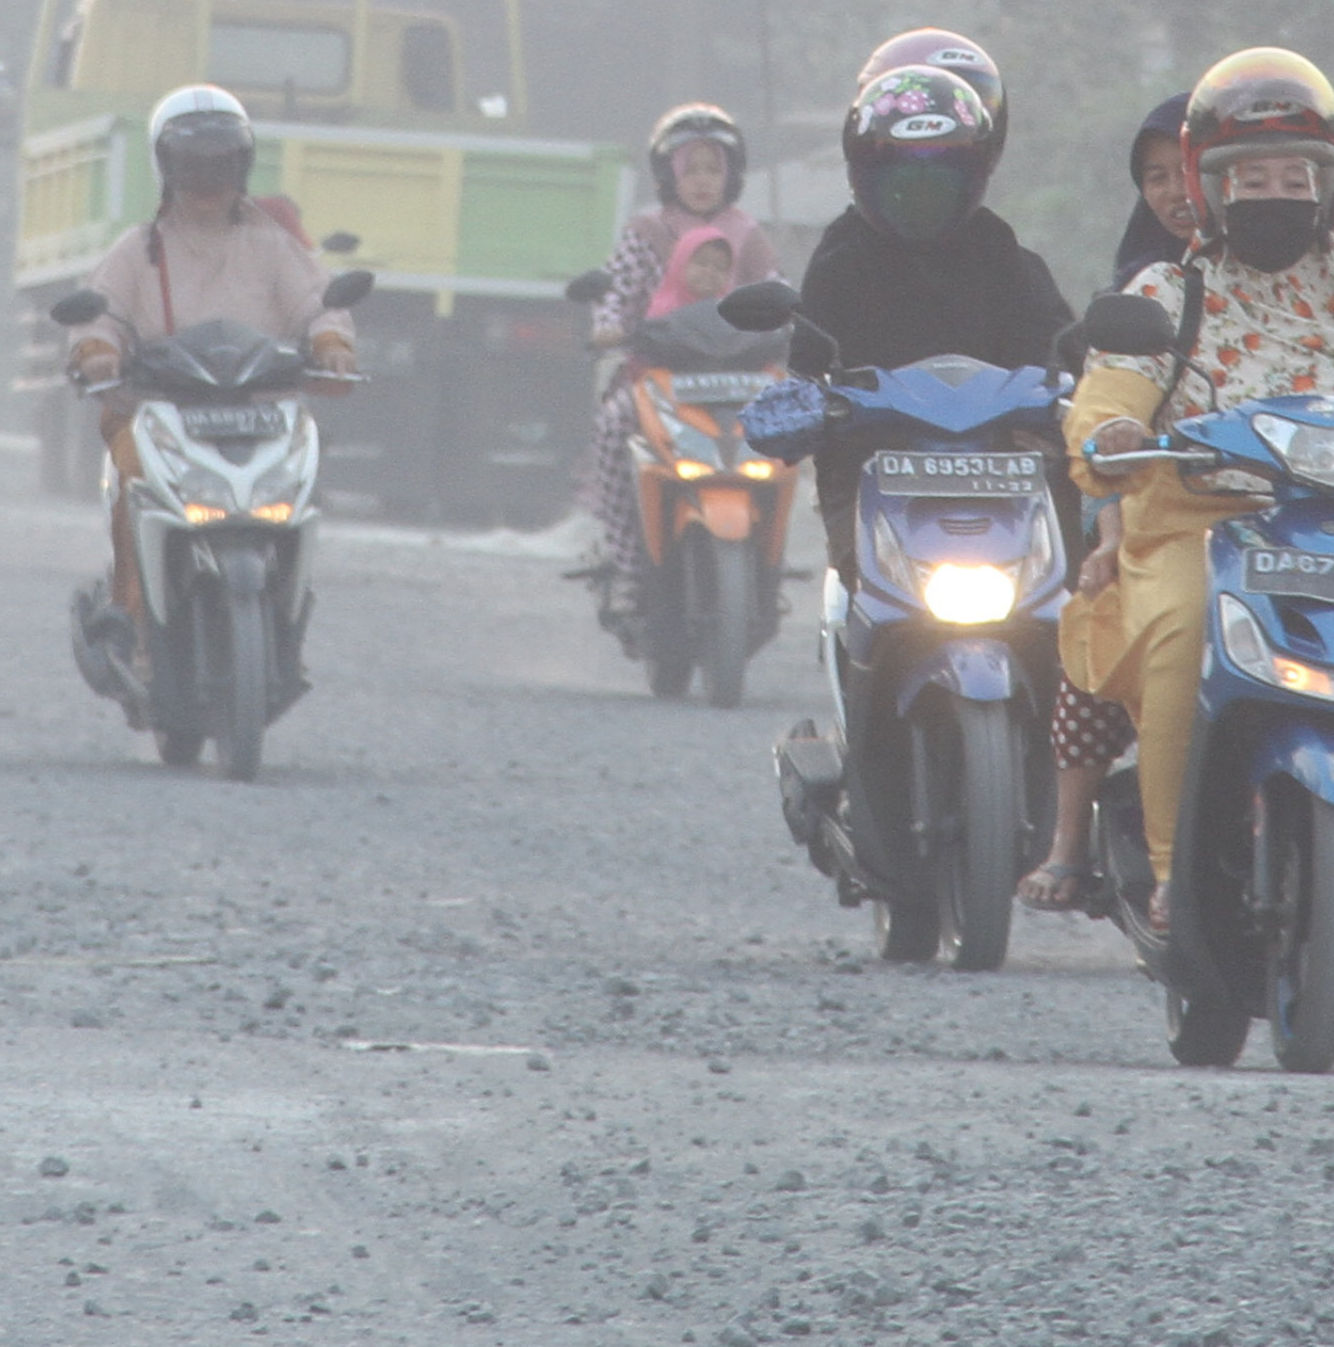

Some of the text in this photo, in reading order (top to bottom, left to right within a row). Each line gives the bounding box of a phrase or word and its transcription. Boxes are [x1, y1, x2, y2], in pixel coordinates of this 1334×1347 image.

[941, 51, 975, 61] GM
[906, 120, 943, 131] GM
[883, 456, 915, 475] DA
